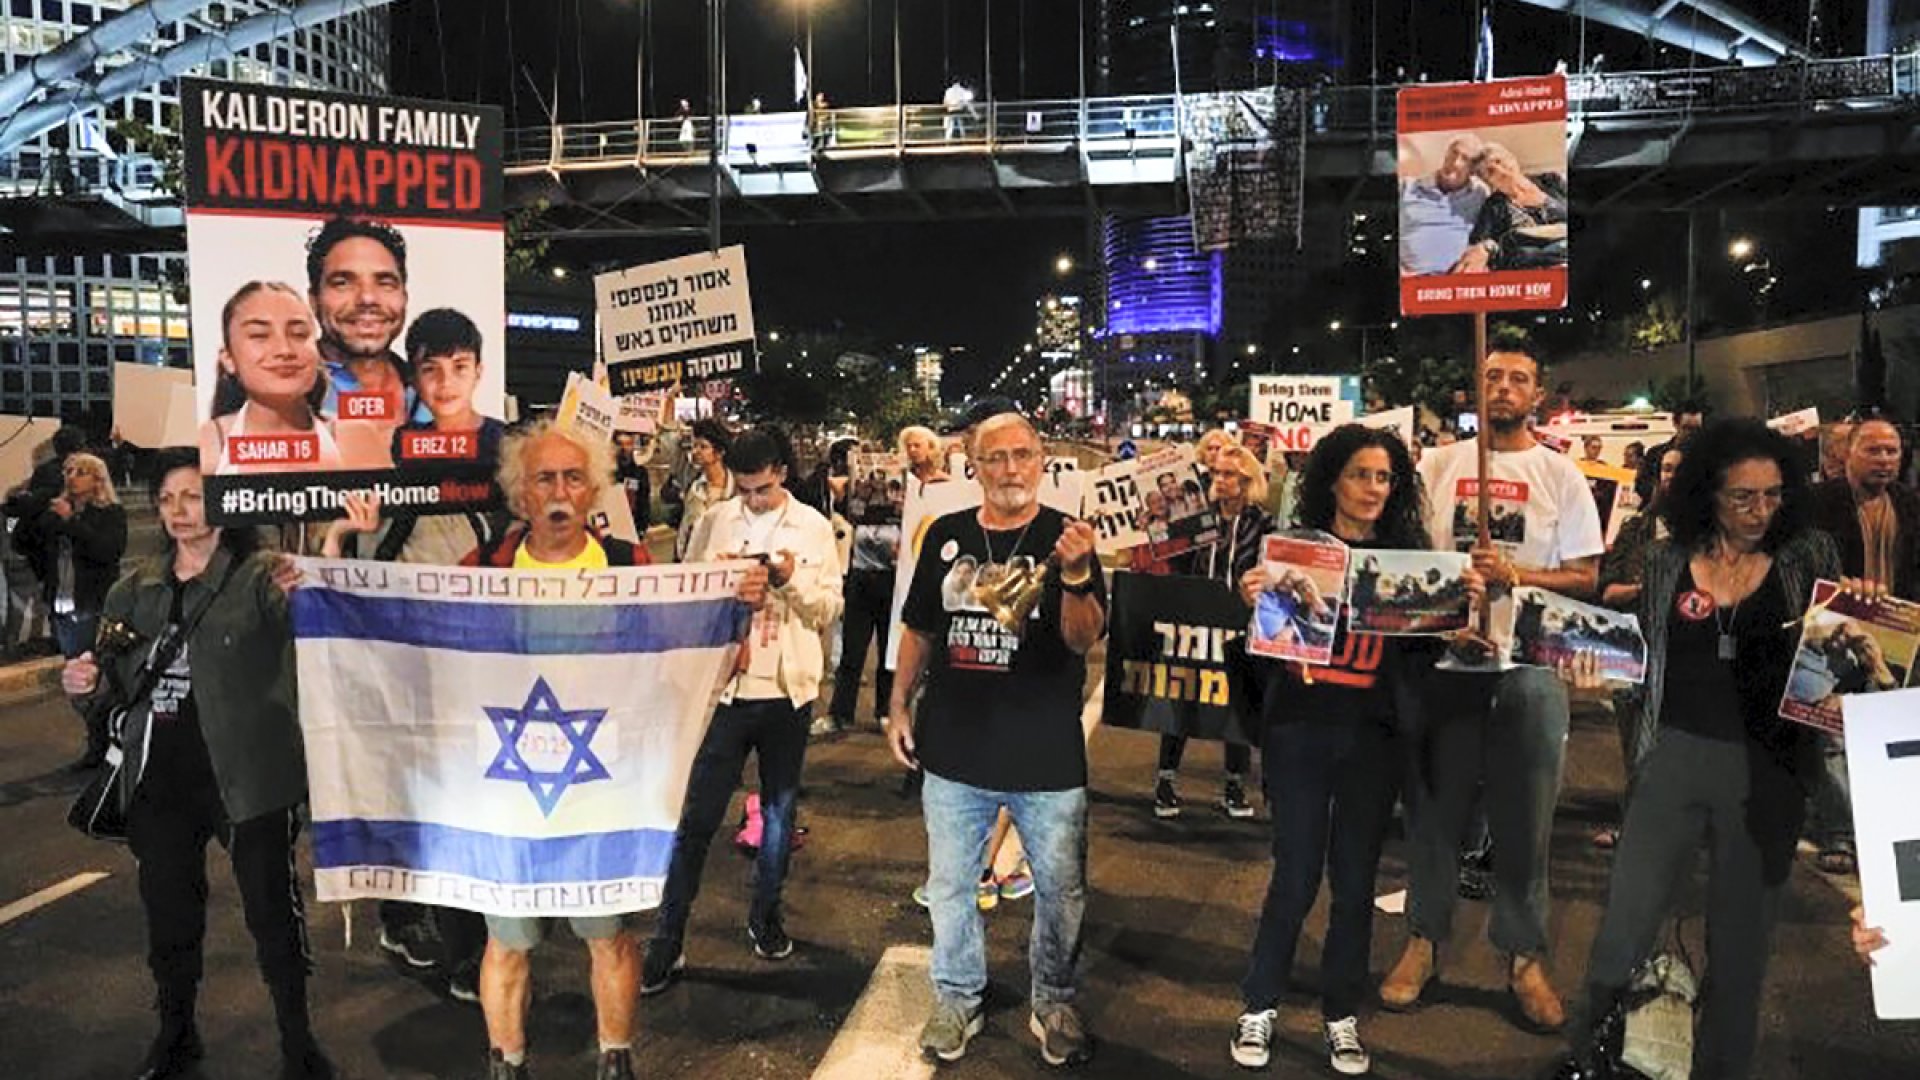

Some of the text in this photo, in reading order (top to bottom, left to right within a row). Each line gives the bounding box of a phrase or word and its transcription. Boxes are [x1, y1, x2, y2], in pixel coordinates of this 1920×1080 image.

[202, 89, 481, 150] KALDERON FAMILY
[1488, 99, 1564, 116] KIDNAPPED
[204, 135, 481, 210] KIDNAPPED
[610, 267, 731, 309] אסור לפספס!
[647, 298, 697, 324] אנחנו
[615, 313, 738, 352] משחקים באש
[686, 351, 743, 378] עסקה
[348, 397, 385, 417] OFER
[1269, 401, 1332, 422] HOME
[236, 441, 288, 460] SAHAR
[412, 436, 467, 455] EREZ 12
[1272, 426, 1311, 449] NO
[1095, 474, 1137, 507] קה
[416, 571, 567, 598] החטופים
[577, 567, 618, 598] כל
